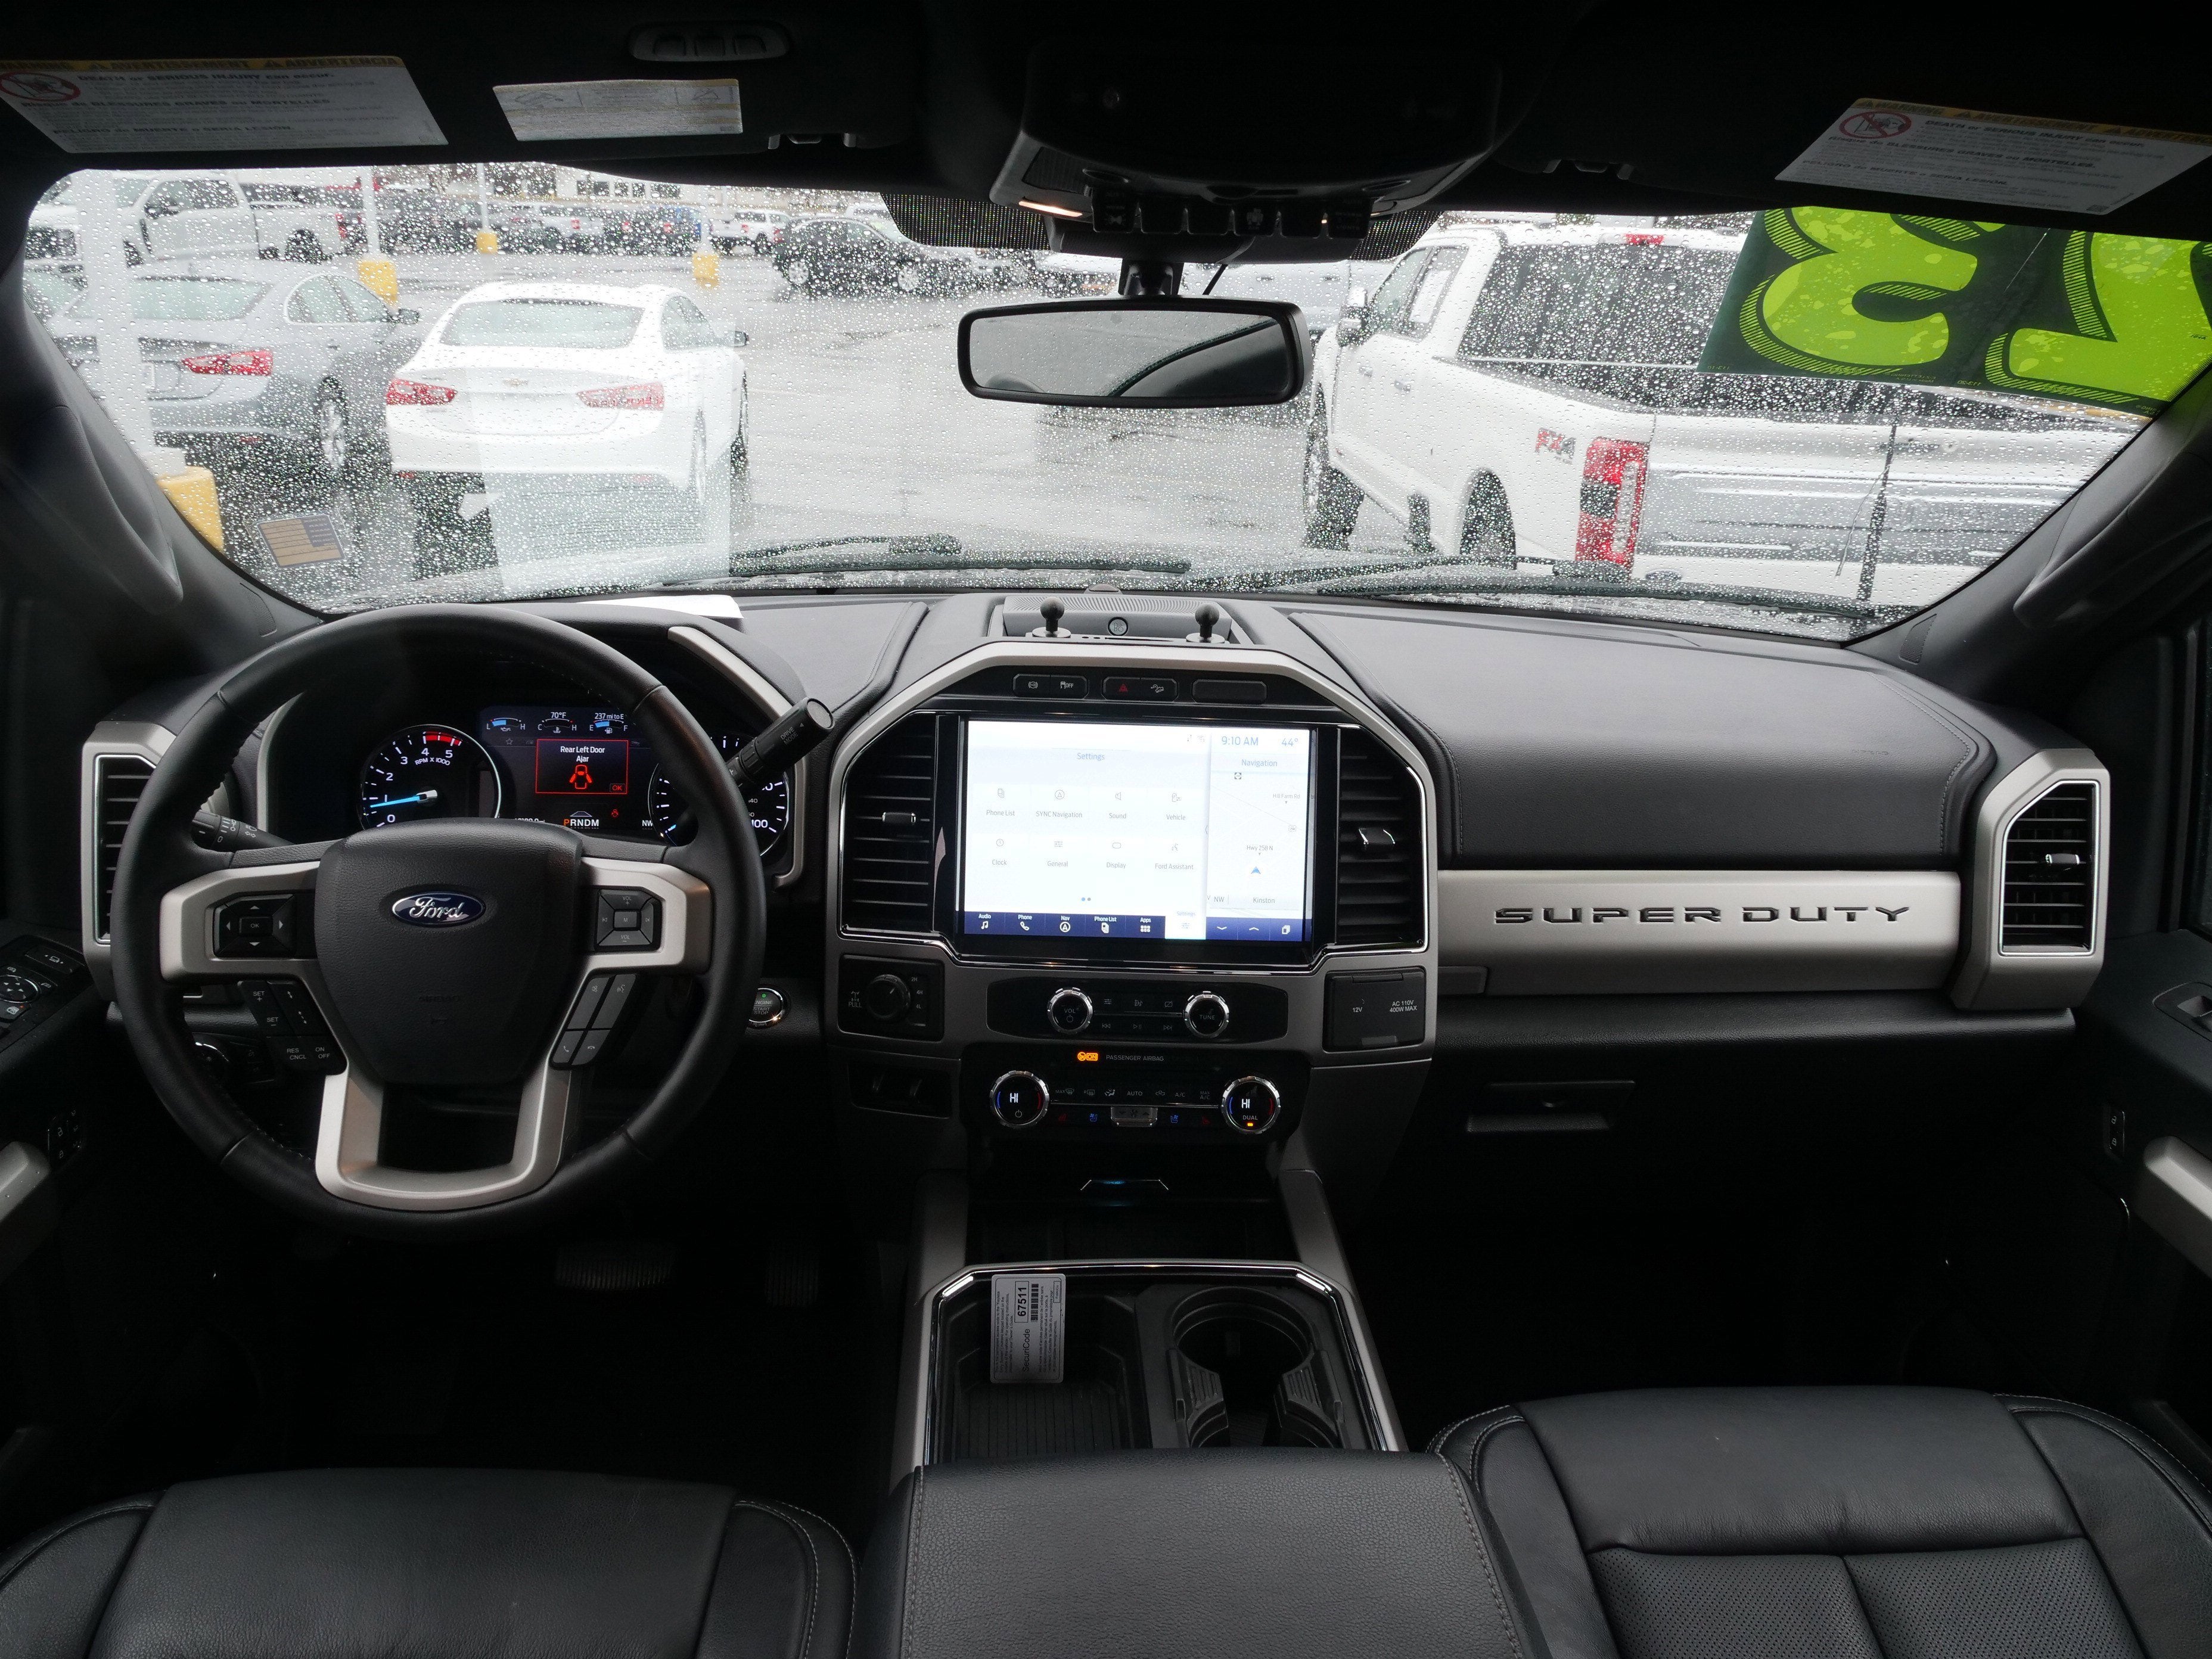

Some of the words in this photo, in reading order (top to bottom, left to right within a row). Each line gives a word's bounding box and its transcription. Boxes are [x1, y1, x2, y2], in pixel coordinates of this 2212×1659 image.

[780, 726, 796, 741] DRIVE
[783, 732, 799, 745] MODE
[1221, 736, 1241, 745] 9:10
[1243, 737, 1259, 745] AM
[421, 747, 430, 756] 4
[445, 750, 453, 758] 5
[400, 756, 408, 765] 3
[415, 757, 428, 766] RPM
[436, 757, 451, 766] 1000
[1077, 752, 1105, 762] Settings
[1241, 759, 1278, 768] Navigation
[386, 772, 393, 781] 2
[387, 814, 396, 823] 0
[1052, 810, 1083, 819] Navigation
[1106, 862, 1126, 870] Display
[409, 896, 470, 919] Ford
[1495, 906, 1723, 924] SUPER
[1742, 906, 1910, 923] DUTY
[1009, 1093, 1019, 1103] HI
[1241, 1098, 1250, 1109] HI
[1017, 1287, 1027, 1317] 67511
[1022, 1328, 1030, 1372] SecuriCode
